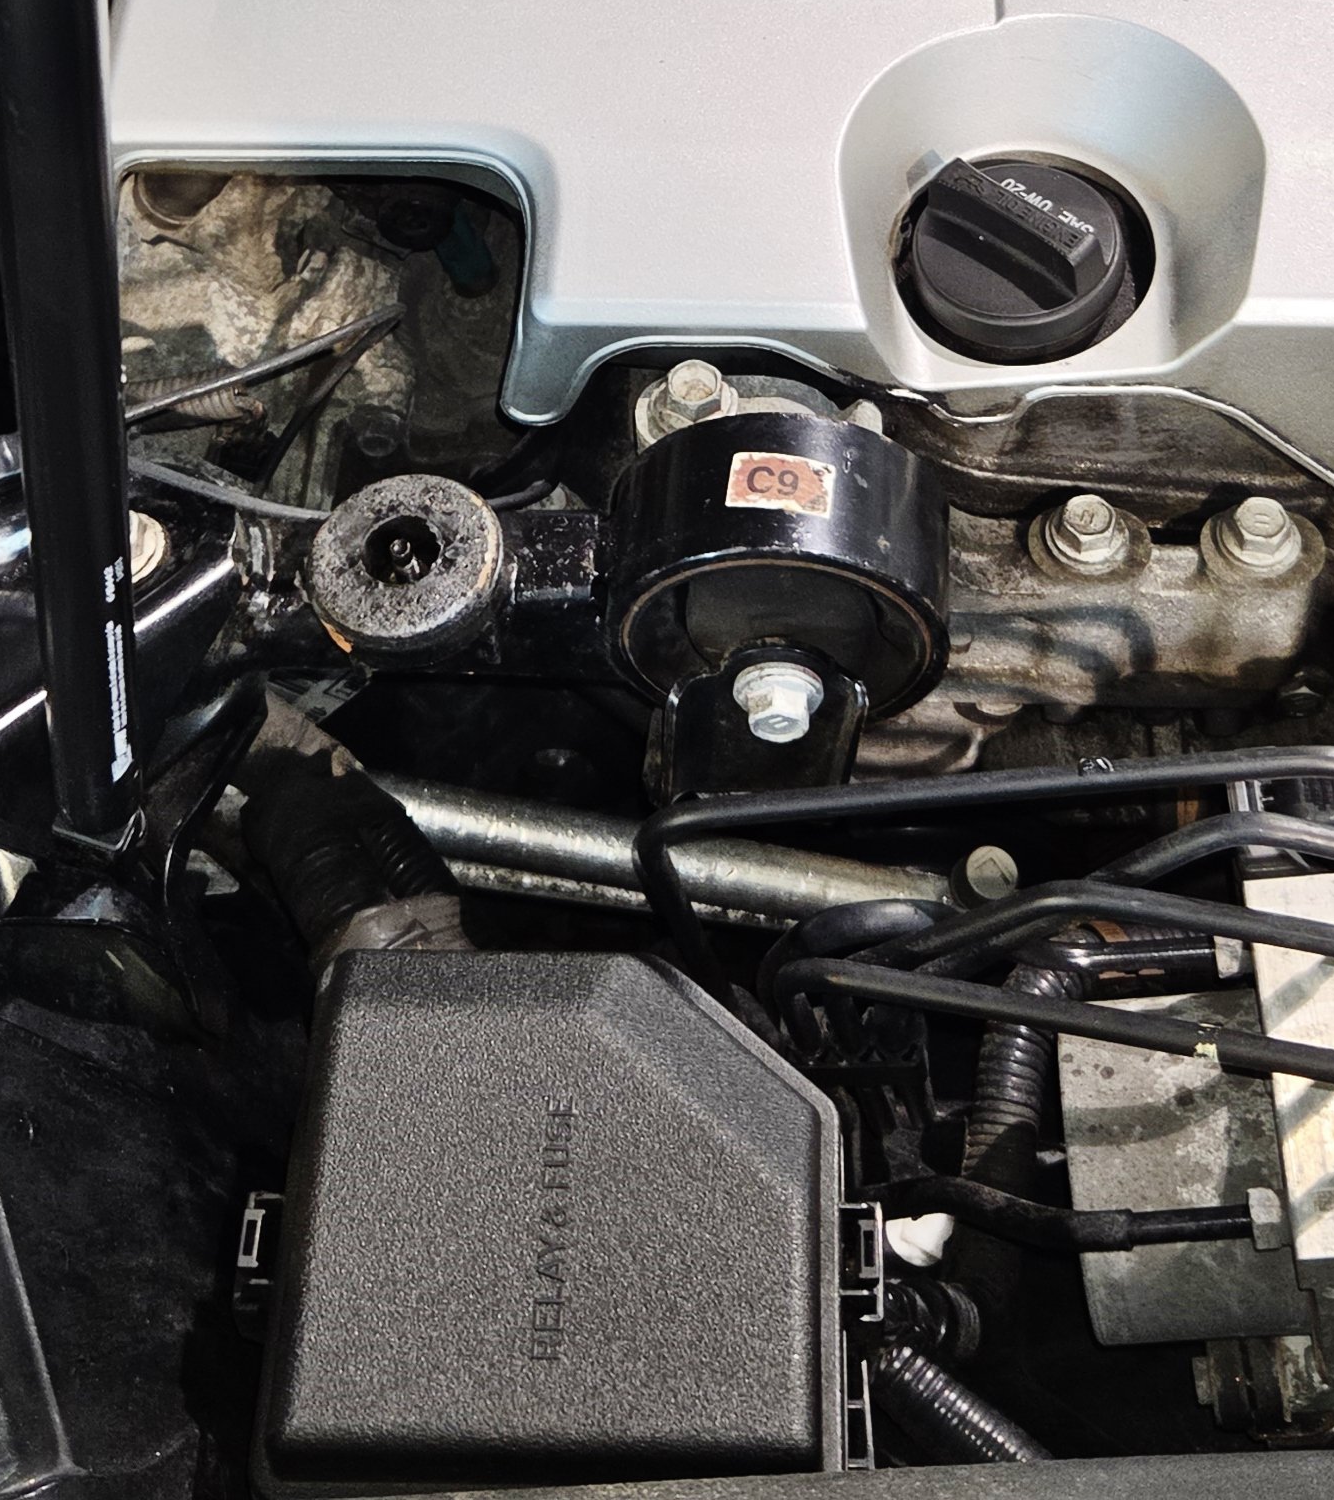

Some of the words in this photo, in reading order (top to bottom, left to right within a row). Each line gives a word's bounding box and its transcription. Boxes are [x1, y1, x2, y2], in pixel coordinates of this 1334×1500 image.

[997, 190, 1018, 212] OIL
[1019, 205, 1079, 249] ENGINE
[746, 465, 799, 496] C9
[543, 1094, 578, 1189] FUSE
[542, 1205, 567, 1229] &
[531, 1239, 566, 1360] RELAY
